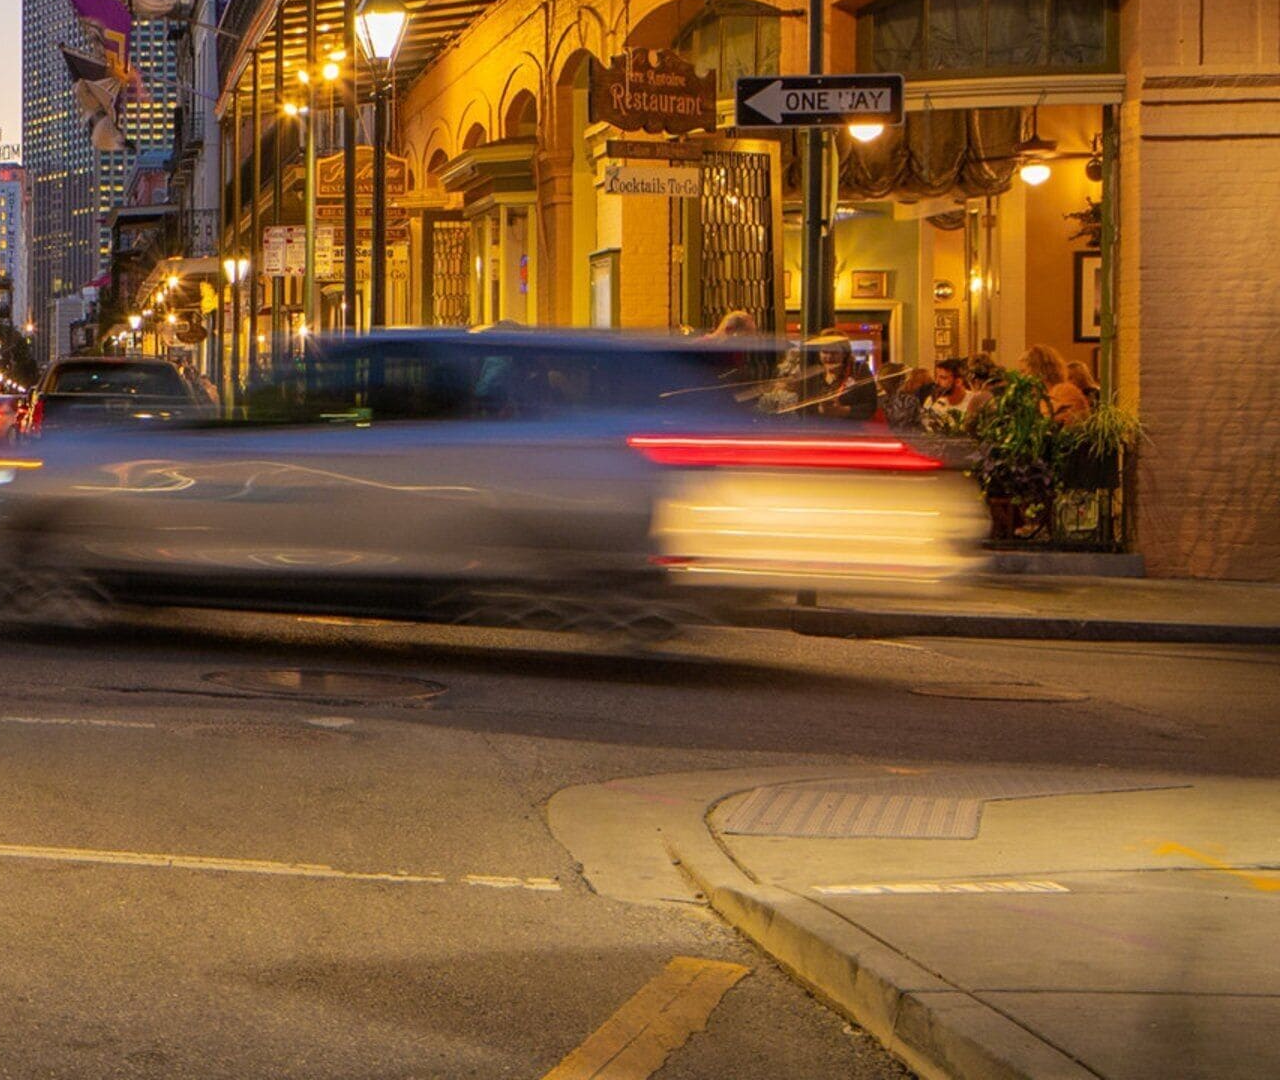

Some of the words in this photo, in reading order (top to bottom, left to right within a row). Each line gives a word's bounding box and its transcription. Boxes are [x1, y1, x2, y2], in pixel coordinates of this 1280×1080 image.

[610, 82, 704, 117] Restaurant
[785, 92, 829, 111] ONE
[607, 174, 666, 195] Cocktails
